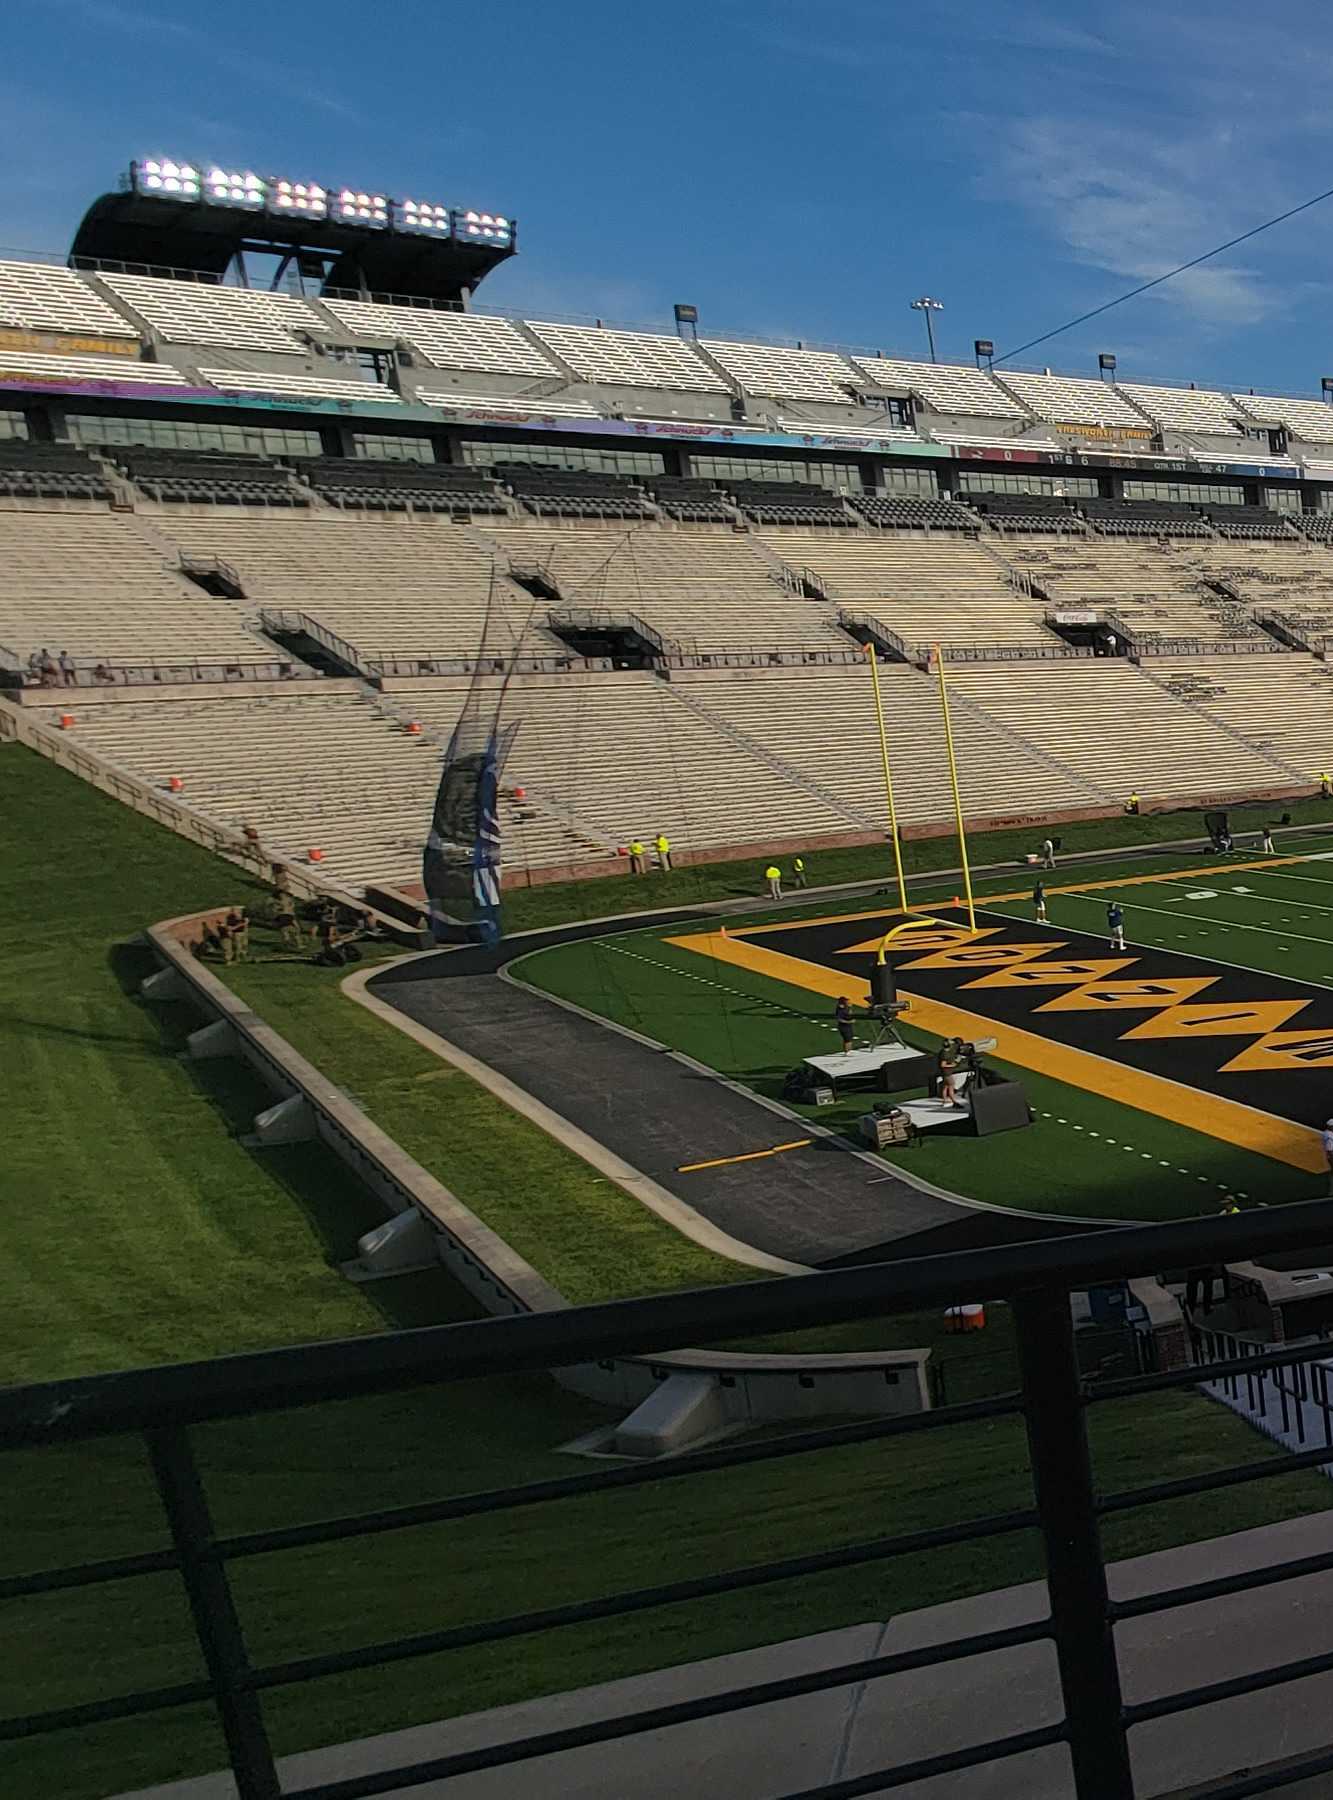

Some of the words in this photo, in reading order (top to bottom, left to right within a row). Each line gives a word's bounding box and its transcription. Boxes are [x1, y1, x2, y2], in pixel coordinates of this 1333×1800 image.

[1081, 455, 1089, 466] 6
[1172, 462, 1187, 471] 1ST
[1215, 465, 1227, 473] 47
